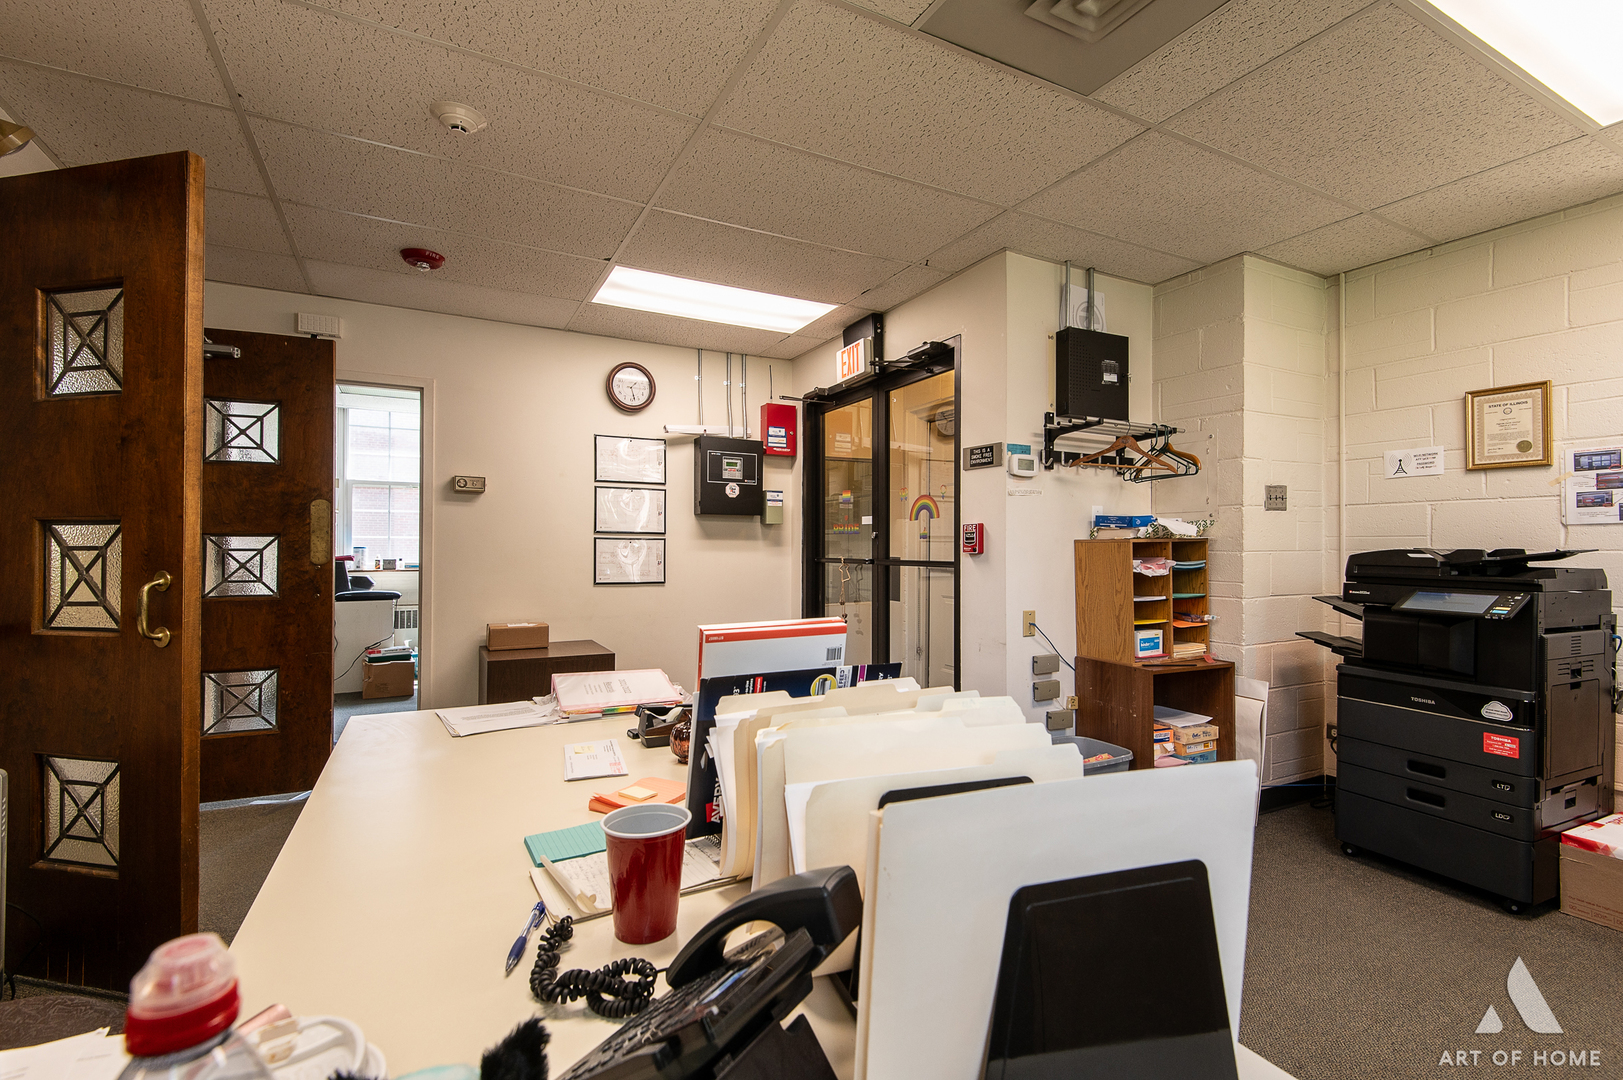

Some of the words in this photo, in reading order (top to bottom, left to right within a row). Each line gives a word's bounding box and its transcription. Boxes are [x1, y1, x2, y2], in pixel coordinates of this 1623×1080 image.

[841, 342, 860, 378] EXIT
[833, 523, 860, 534] PRIDE
[1411, 696, 1435, 704] TOSHIBA
